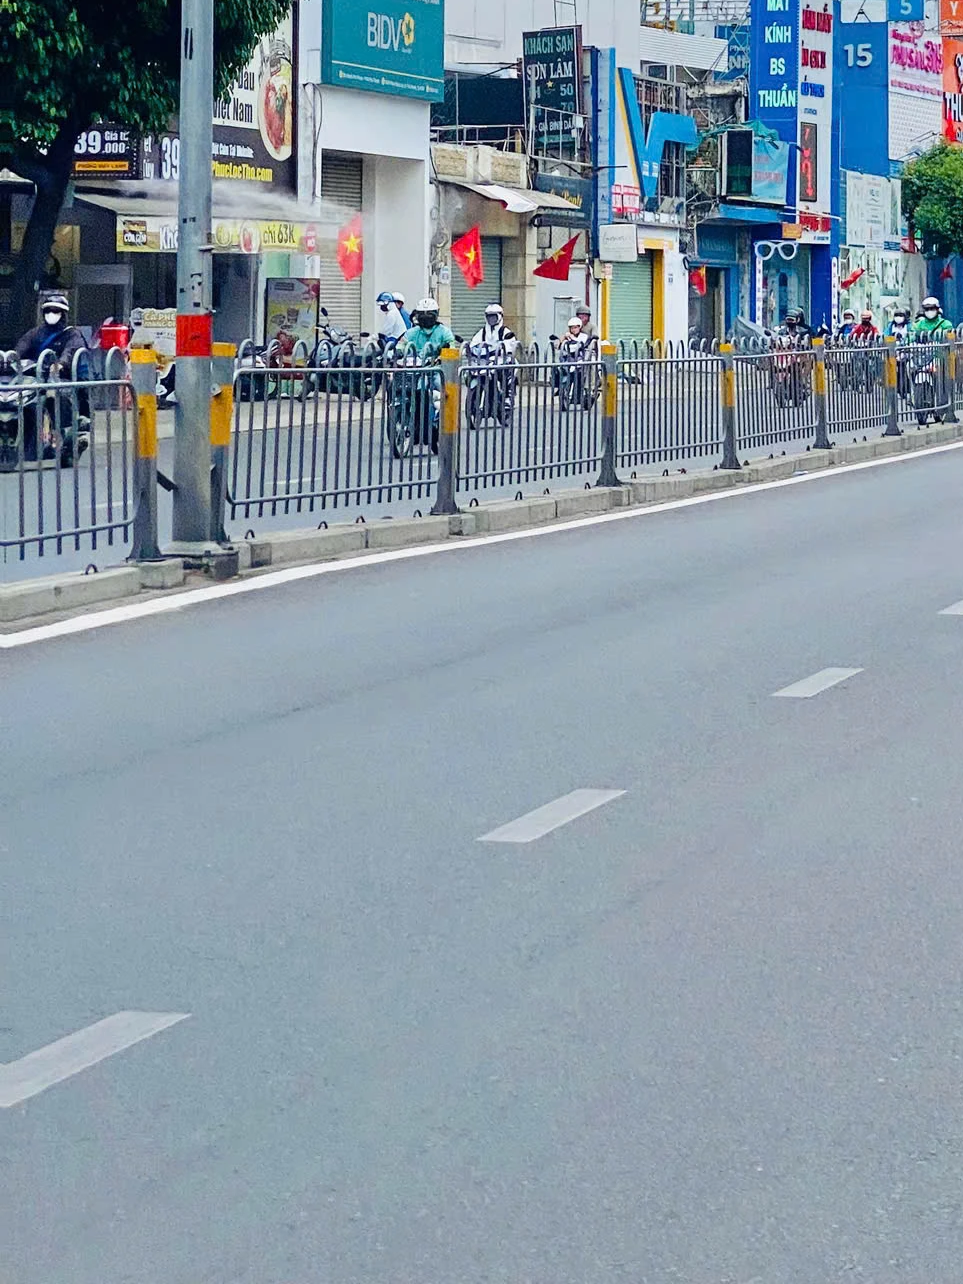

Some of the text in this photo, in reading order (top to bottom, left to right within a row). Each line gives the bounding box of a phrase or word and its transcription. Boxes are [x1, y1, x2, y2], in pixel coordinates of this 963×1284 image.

[949, 1, 958, 16] Y
[367, 11, 402, 52] BIDV
[764, 21, 792, 43] KÍNH
[524, 32, 574, 56] KHÁCH SẠN
[550, 57, 573, 79] LÂM
[769, 58, 785, 75] BS
[758, 84, 797, 108] THUẦN
[232, 97, 253, 124] Nam
[74, 130, 102, 154] 39
